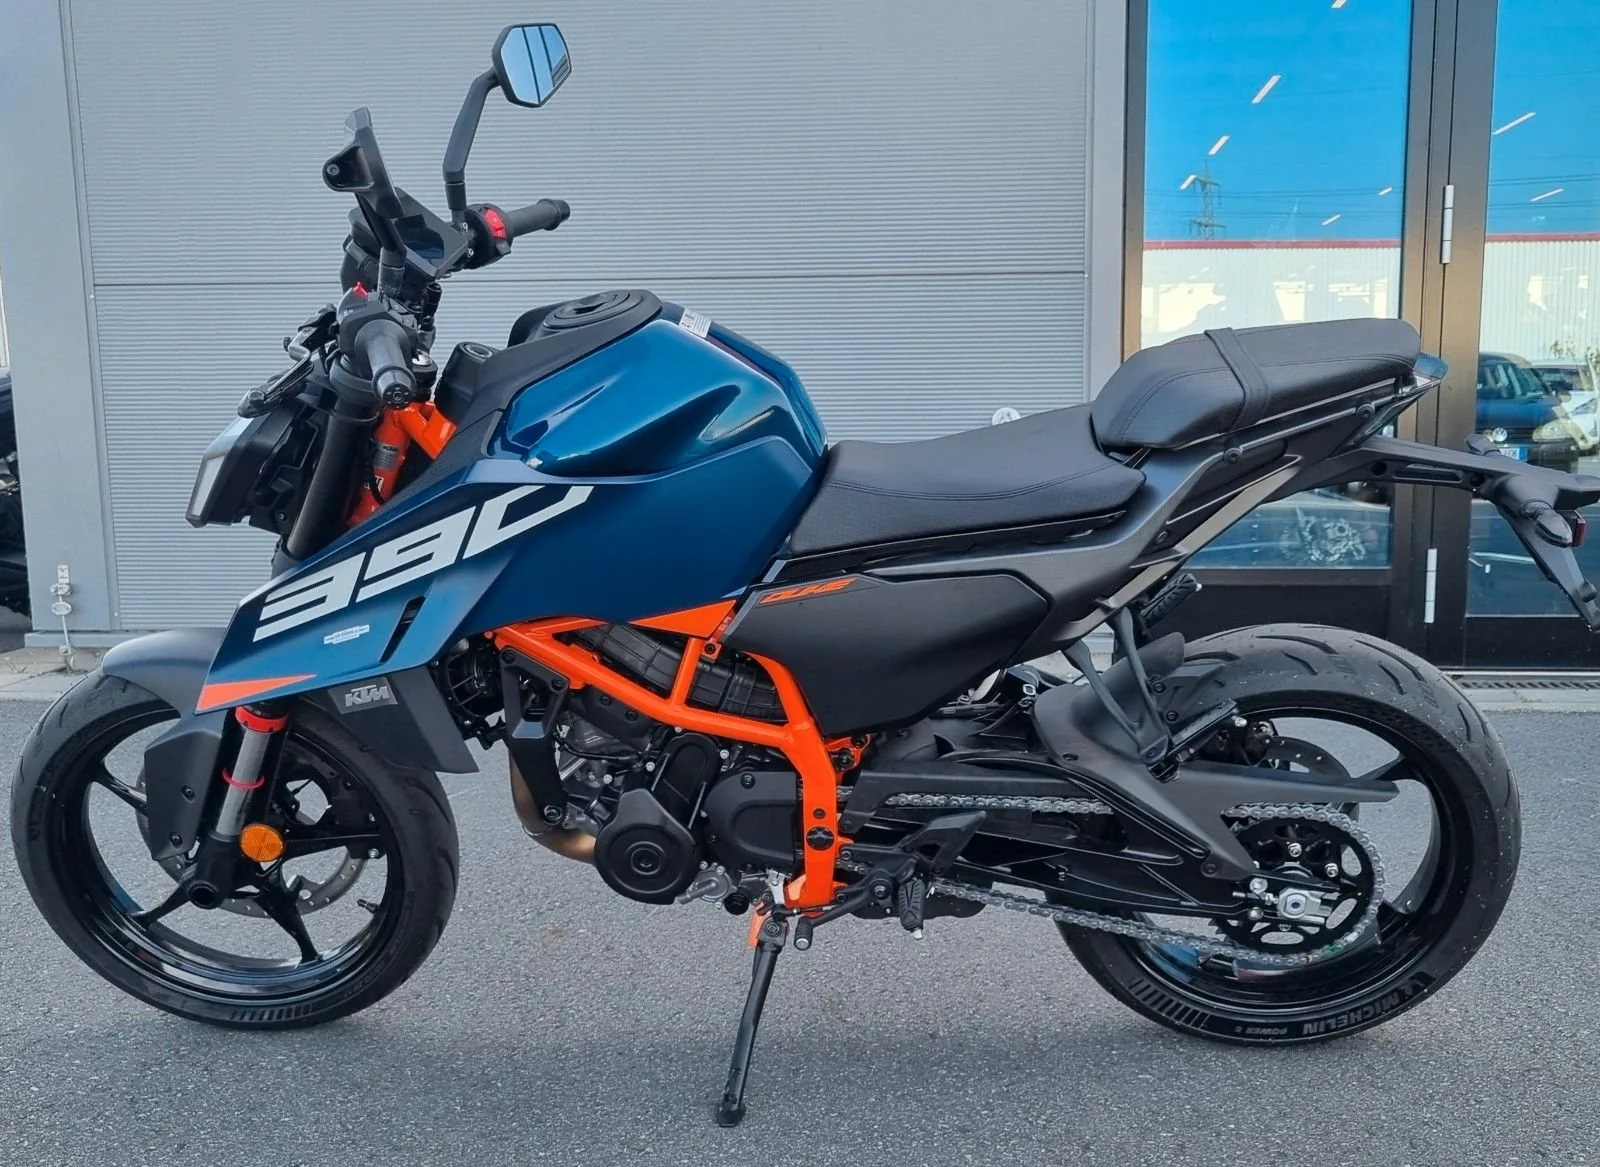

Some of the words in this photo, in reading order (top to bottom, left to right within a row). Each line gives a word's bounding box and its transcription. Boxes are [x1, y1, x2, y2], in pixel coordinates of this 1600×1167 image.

[253, 485, 595, 643] 390
[344, 684, 390, 707] KTM
[1246, 1025, 1288, 1036] POWER
[1302, 991, 1400, 1036] MICHELIN
